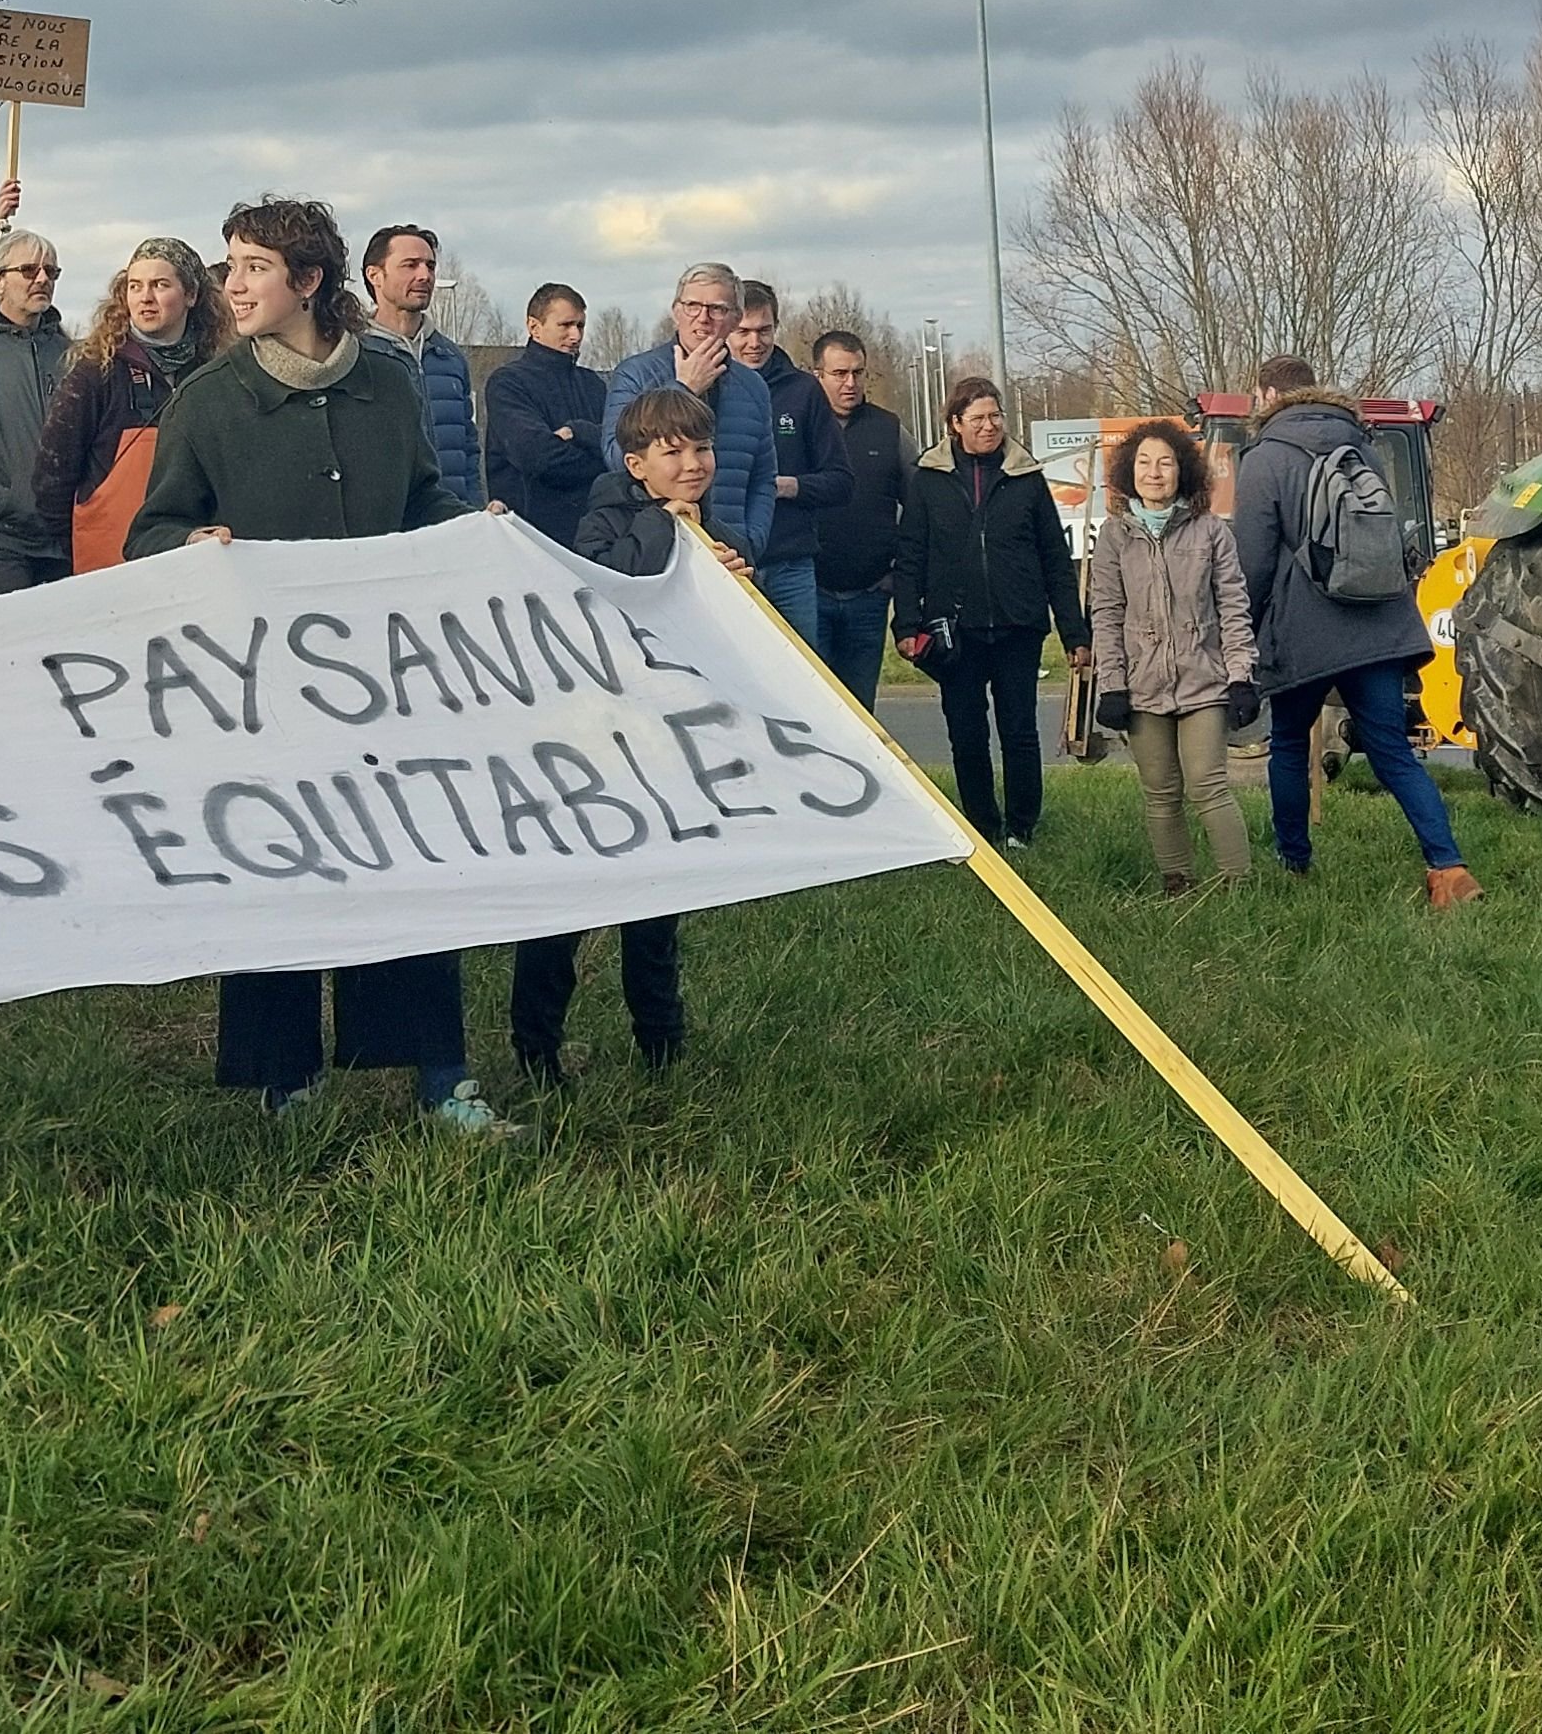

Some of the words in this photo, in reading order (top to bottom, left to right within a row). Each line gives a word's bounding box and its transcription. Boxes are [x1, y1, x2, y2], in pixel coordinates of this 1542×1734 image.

[22, 17, 67, 34] NOUS
[35, 38, 60, 51] LA
[43, 586, 705, 739] PAYSANNE
